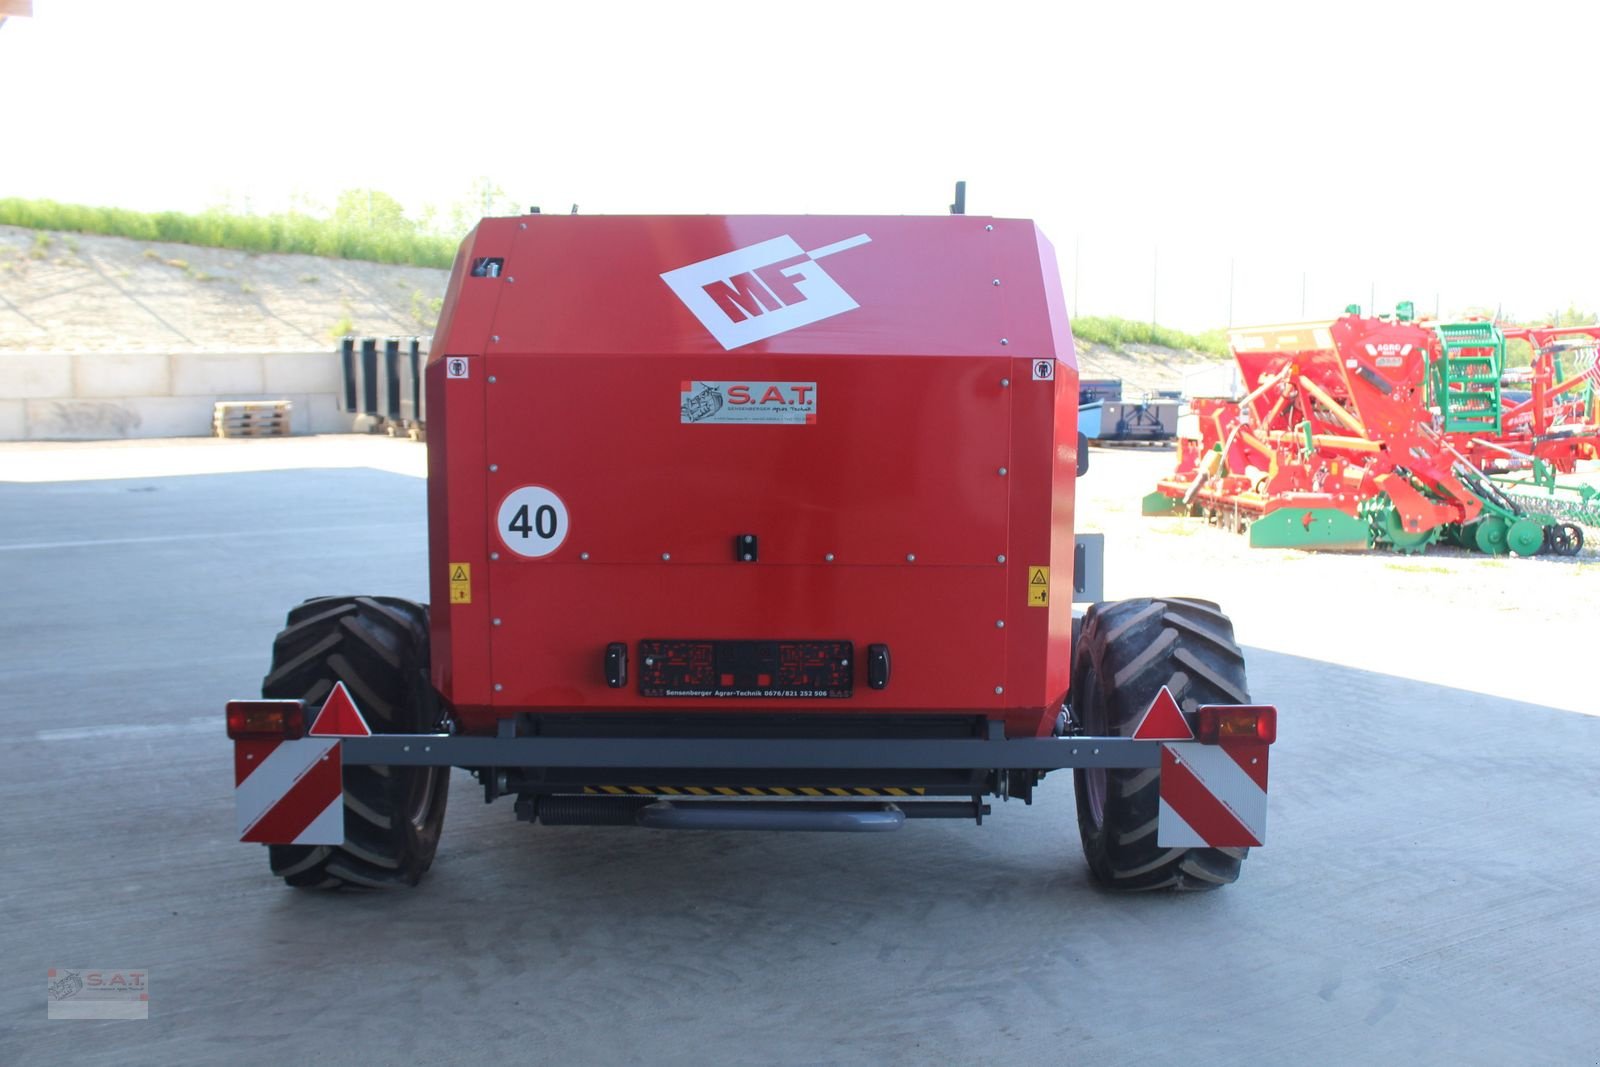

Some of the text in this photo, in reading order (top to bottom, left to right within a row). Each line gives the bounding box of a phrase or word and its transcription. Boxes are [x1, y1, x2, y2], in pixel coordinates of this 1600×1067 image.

[702, 253, 811, 324] MF
[1377, 343, 1401, 352] AGRO
[727, 385, 813, 405] S.A.T.
[508, 504, 557, 539] 40
